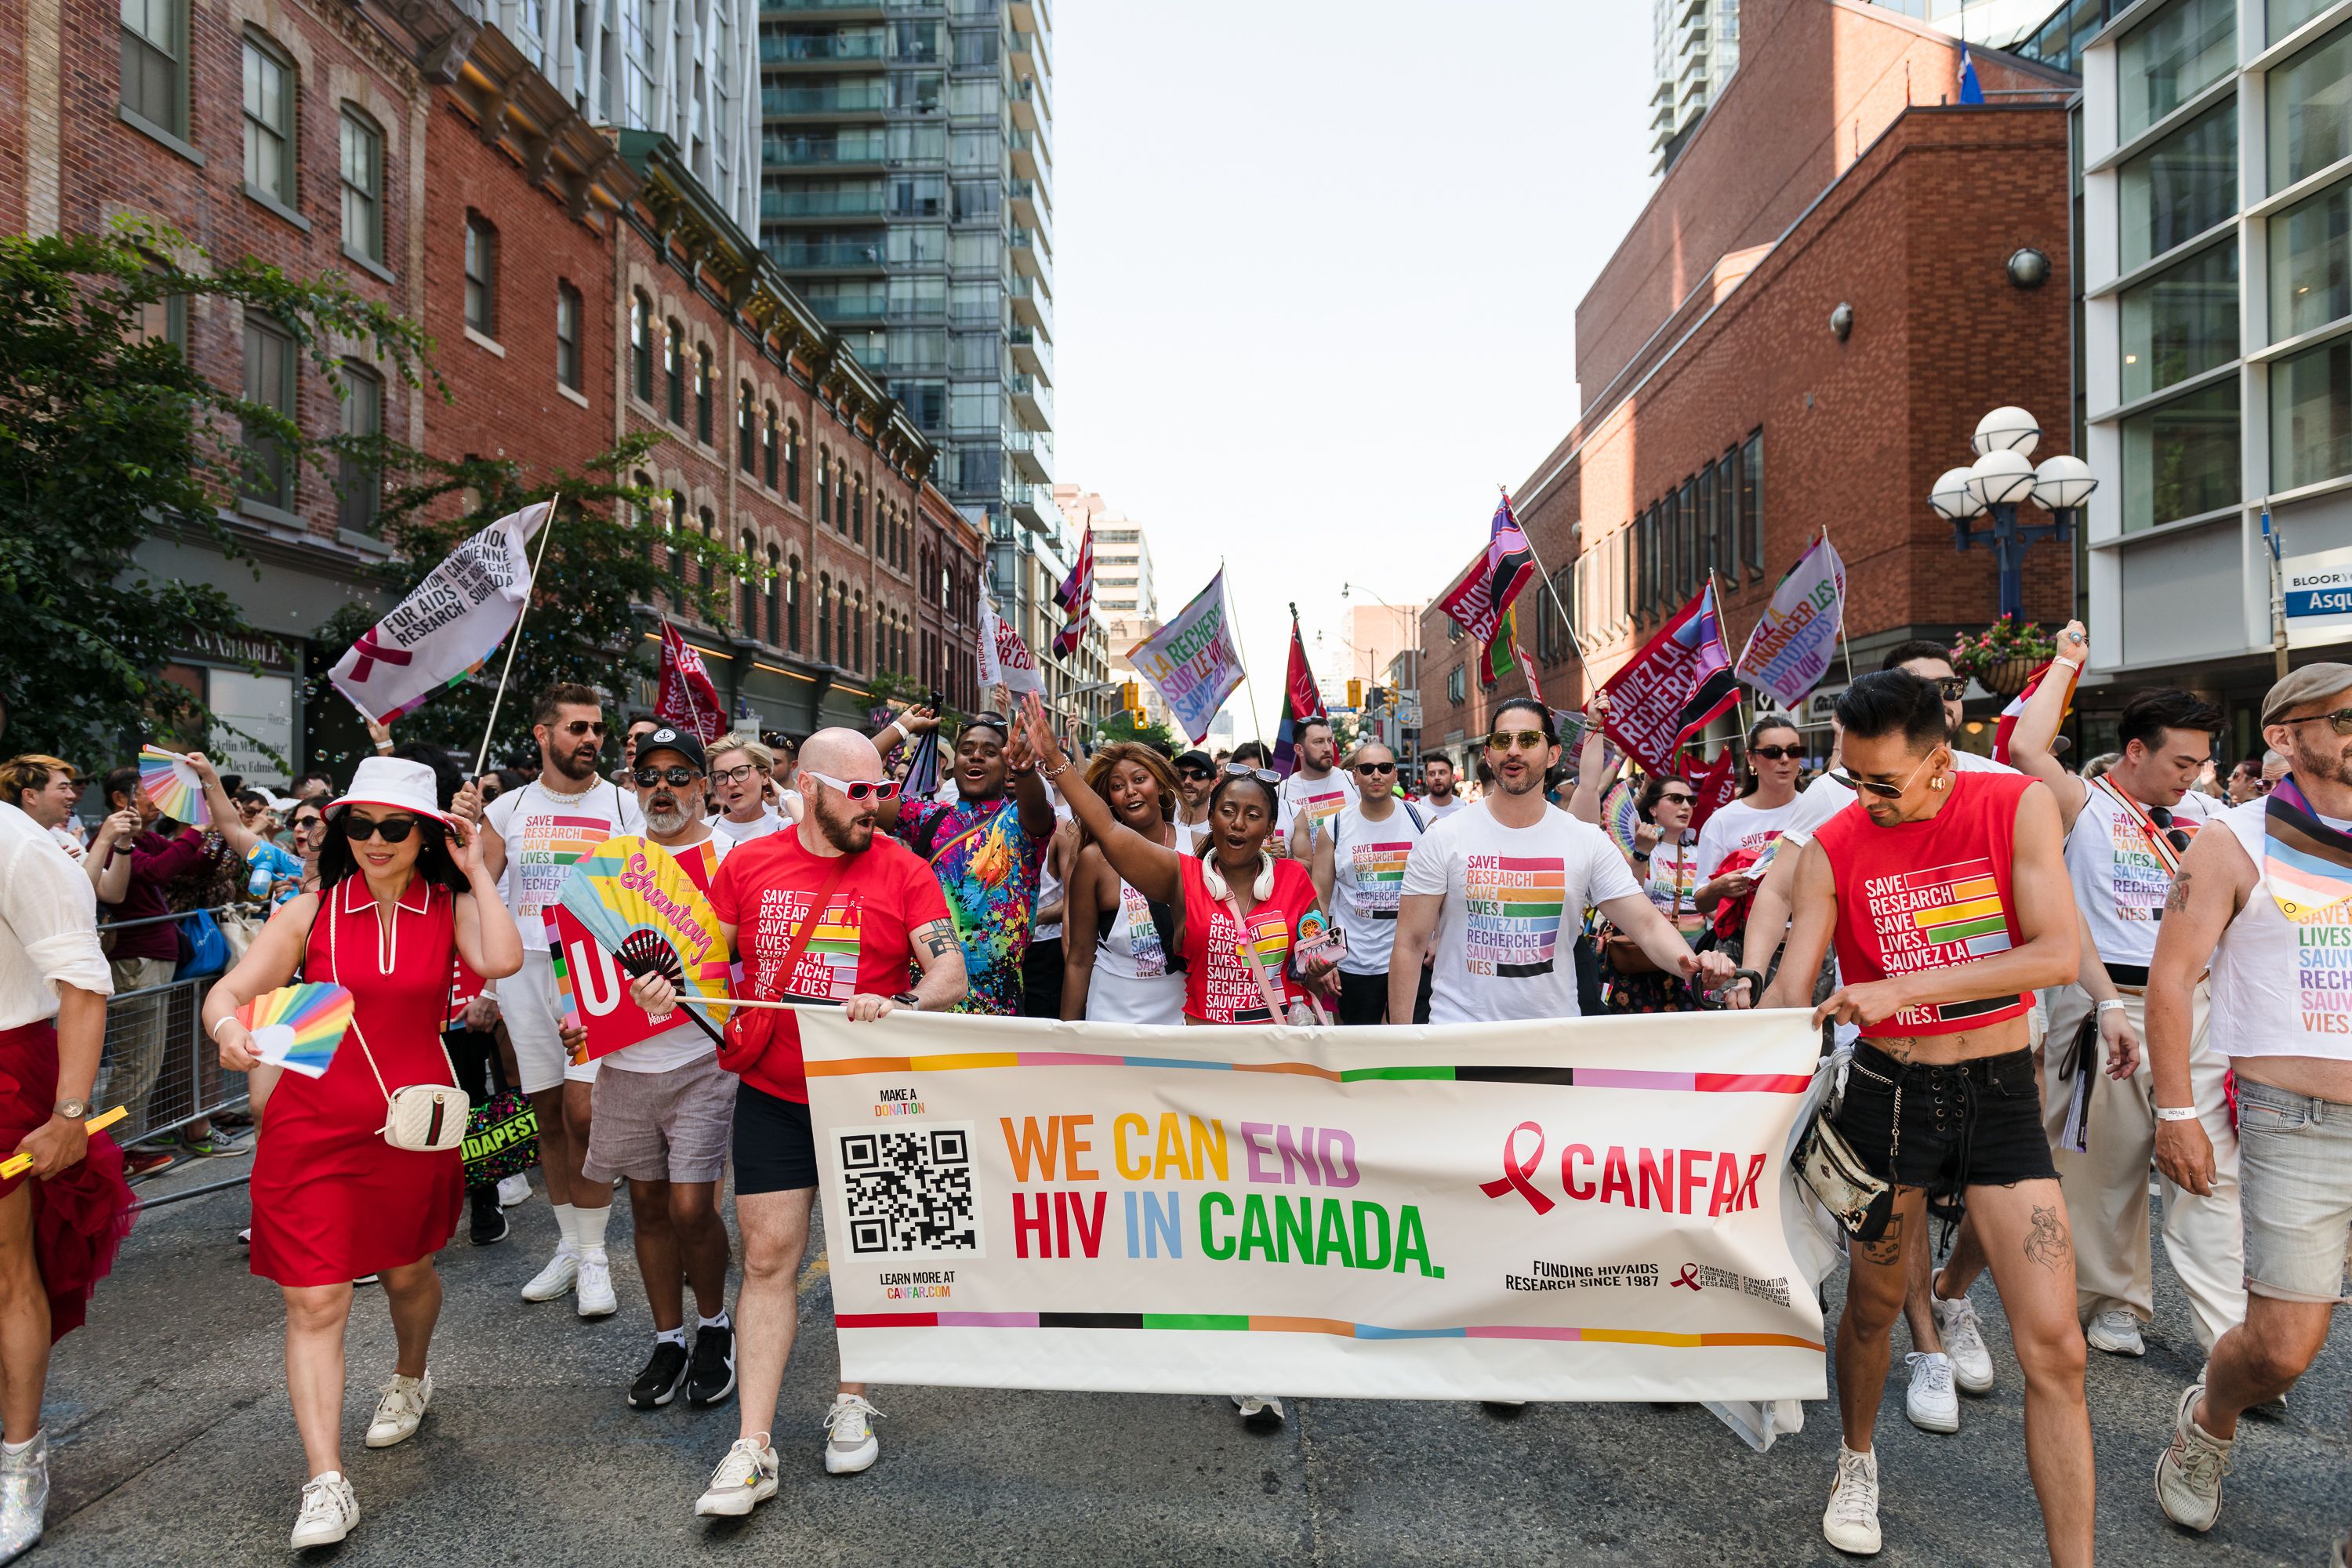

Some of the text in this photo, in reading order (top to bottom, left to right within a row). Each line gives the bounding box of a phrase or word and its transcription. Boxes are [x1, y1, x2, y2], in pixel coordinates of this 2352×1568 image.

[383, 584, 456, 634] FOR AIDS
[394, 601, 466, 648] RESEARCH
[1744, 579, 1836, 677] FINANCER LES
[1144, 653, 1174, 682] LA
[1160, 650, 1213, 702] SUR LE
[1608, 641, 1686, 725] SAUVEZ LA
[1774, 668, 1802, 696] DU
[526, 815, 552, 826] SAVE
[2113, 813, 2134, 826] SAV
[524, 828, 580, 839] RESEARCH
[1741, 833, 1764, 848] SAVE
[522, 840, 548, 851] SAVE
[1352, 844, 1372, 855] SAVE
[2114, 838, 2147, 853] SAVE
[521, 852, 552, 865] LIVES.
[1353, 852, 1392, 864] RESEARCH
[1468, 855, 1497, 869] SAVE
[2114, 850, 2153, 868] LIVES.
[521, 866, 559, 878] SAUVEZ
[1354, 863, 1372, 873] SAVE
[2113, 864, 2162, 883] SAUVEZ
[1356, 873, 1377, 882] LIVES.
[1467, 870, 1532, 887] RESEARCH
[1385, 881, 1394, 891] LA
[1465, 884, 1496, 900] SAVE
[1865, 874, 1904, 898] SAVE
[761, 889, 793, 905] SAVE
[1356, 891, 1399, 902] RECHERCHE
[1869, 886, 1953, 916] RESEARCH
[517, 905, 539, 916] VIES.
[619, 852, 713, 966] Shantay
[1355, 908, 1372, 919] VIES.
[1467, 900, 1502, 916] LIVES.
[2116, 907, 2151, 921] VIES.
[758, 920, 788, 935] SAVE
[1468, 914, 1529, 933] SAUVEZ LA
[1874, 913, 1914, 935] SAVE
[1468, 929, 1538, 948] RECHERCHE
[1878, 931, 1927, 953] LIVES.
[1208, 940, 1235, 955] SAVE
[1467, 944, 1539, 964] SAUVEZ DES
[1208, 953, 1240, 968] LIVES.
[1882, 946, 1944, 971] SAUVEZ
[1946, 941, 1967, 961] LA
[1207, 967, 1249, 982] SAUVEZ
[1466, 959, 1495, 976] VIES.
[801, 978, 828, 996] DES
[1206, 994, 1267, 1009] SAUVEZ DES
[1205, 1009, 1232, 1024] VIES.
[1895, 1005, 1937, 1025] VIES.
[880, 1088, 917, 1102] MAKE A
[874, 1102, 925, 1116] DONATION
[461, 1112, 539, 1162] UDAPEST
[1000, 1112, 1360, 1189] WE CAN END
[1561, 1143, 1767, 1217] CANFAR
[1012, 1191, 1445, 1279] HIV IN CANADA.
[1534, 1260, 1659, 1278] FUNDING HIV/AIDS
[1699, 1265, 1738, 1278] CANADIAN
[1699, 1269, 1739, 1283] FOUNDATION
[880, 1271, 955, 1285] LEARN MORE AT
[1505, 1274, 1659, 1291] RESEARCH SINCE 1987
[1719, 1276, 1739, 1287] AIDS
[1743, 1276, 1788, 1288] FONDATION
[887, 1285, 950, 1299] CANFAR.COM
[1700, 1281, 1740, 1291] RESEARCH
[1744, 1282, 1791, 1295] CANADIENNE
[1744, 1289, 1760, 1298] SUR
[1772, 1298, 1791, 1308] SIDA
[1753, 1288, 1791, 1301] RECHERCHE
